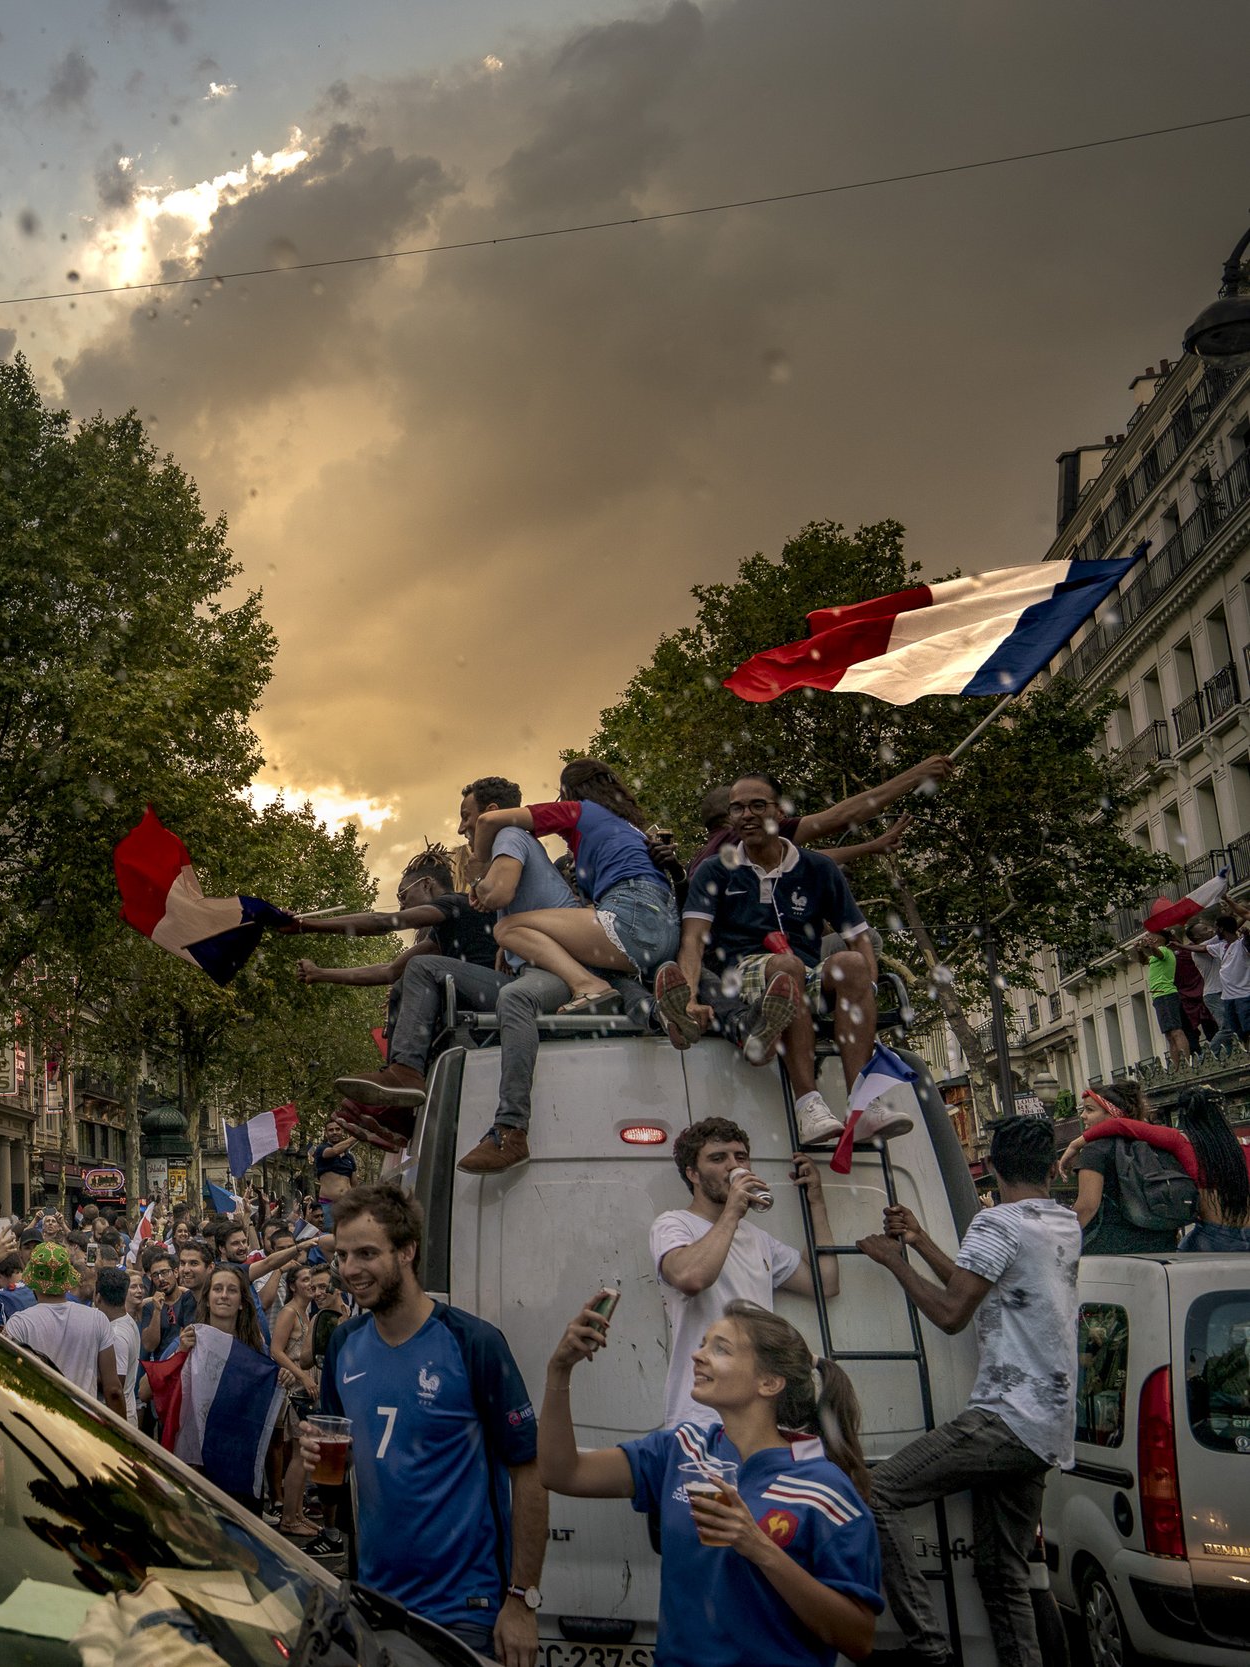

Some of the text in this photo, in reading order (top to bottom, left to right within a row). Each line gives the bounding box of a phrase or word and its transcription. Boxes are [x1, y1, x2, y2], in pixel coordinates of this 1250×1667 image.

[376, 1406, 398, 1459] 7
[548, 1528, 575, 1541] LT
[1203, 1542, 1250, 1558] RENAU
